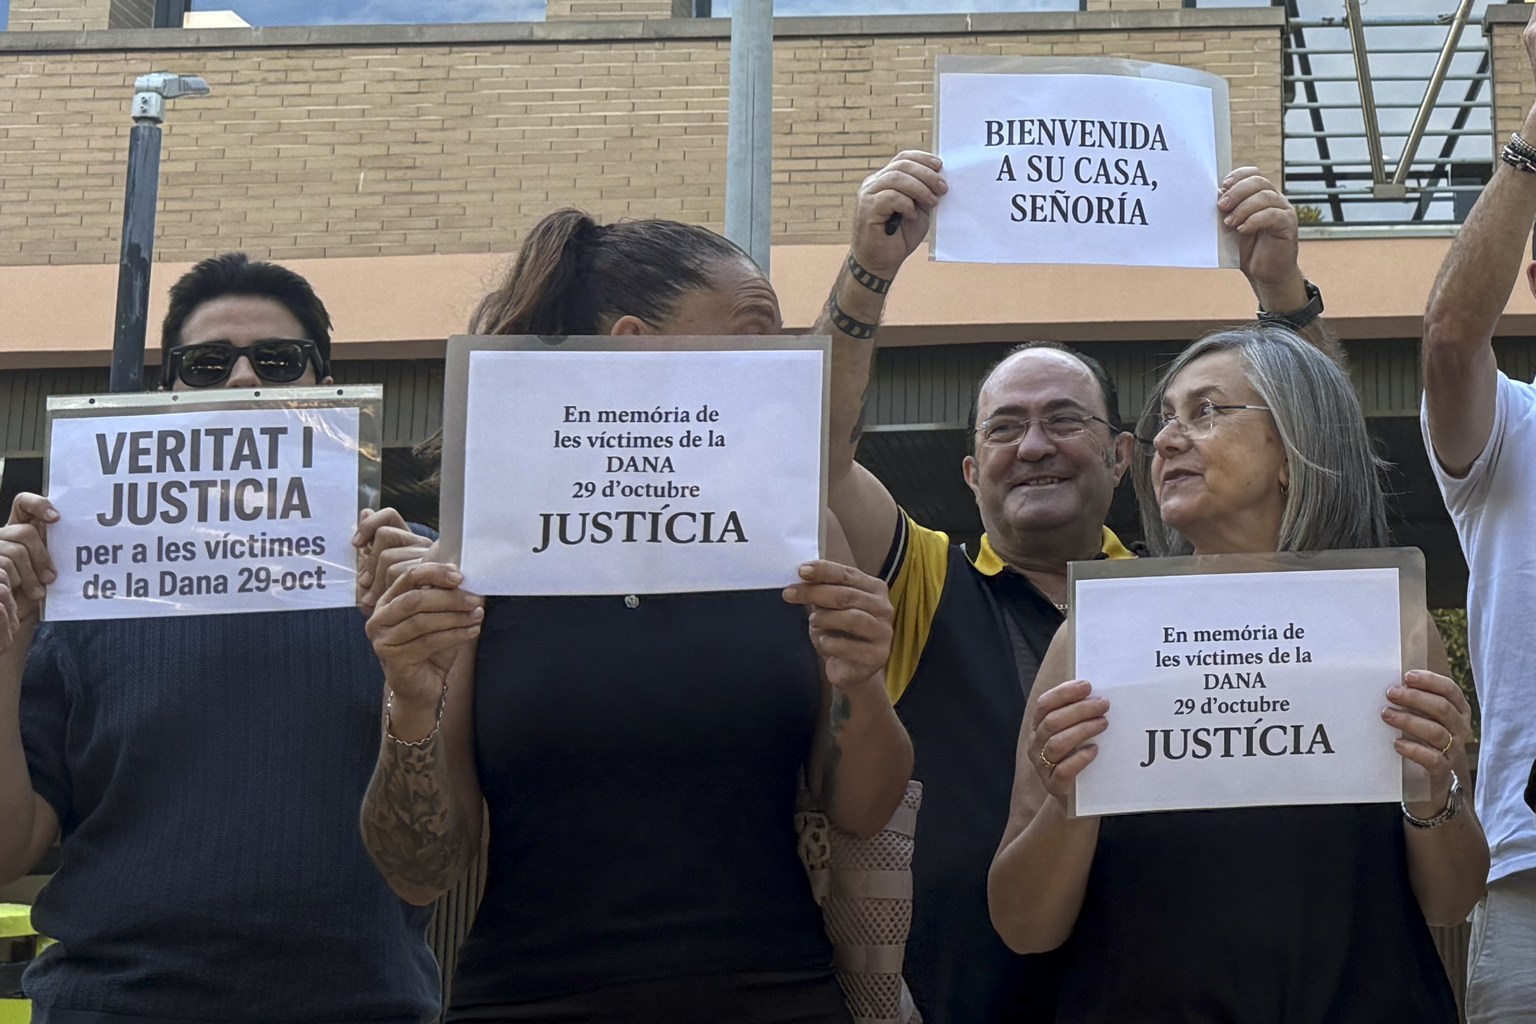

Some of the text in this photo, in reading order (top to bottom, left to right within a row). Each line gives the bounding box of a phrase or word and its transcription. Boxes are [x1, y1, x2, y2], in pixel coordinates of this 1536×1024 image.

[984, 118, 1169, 152] BIENVENIDA
[995, 154, 1158, 192] A SU CASA,
[1010, 189, 1149, 226] SEÑORÍA
[562, 404, 720, 424] En memória de
[95, 426, 314, 476] VERITAT I
[553, 429, 726, 449] les víctimes de la
[605, 455, 676, 474] DANA
[96, 476, 312, 527] JUSTICIA
[572, 481, 597, 499] 29
[532, 503, 749, 554] JUSTÍCIA
[76, 531, 326, 573] per a les víctimes
[82, 565, 327, 600] de la Dana 29-oct
[1162, 622, 1305, 644] En memória de
[1155, 646, 1313, 668] les víctimes de la
[1203, 671, 1267, 690] DANA
[1173, 698, 1196, 715] 29
[1139, 717, 1336, 768] JUSTÍCIA
